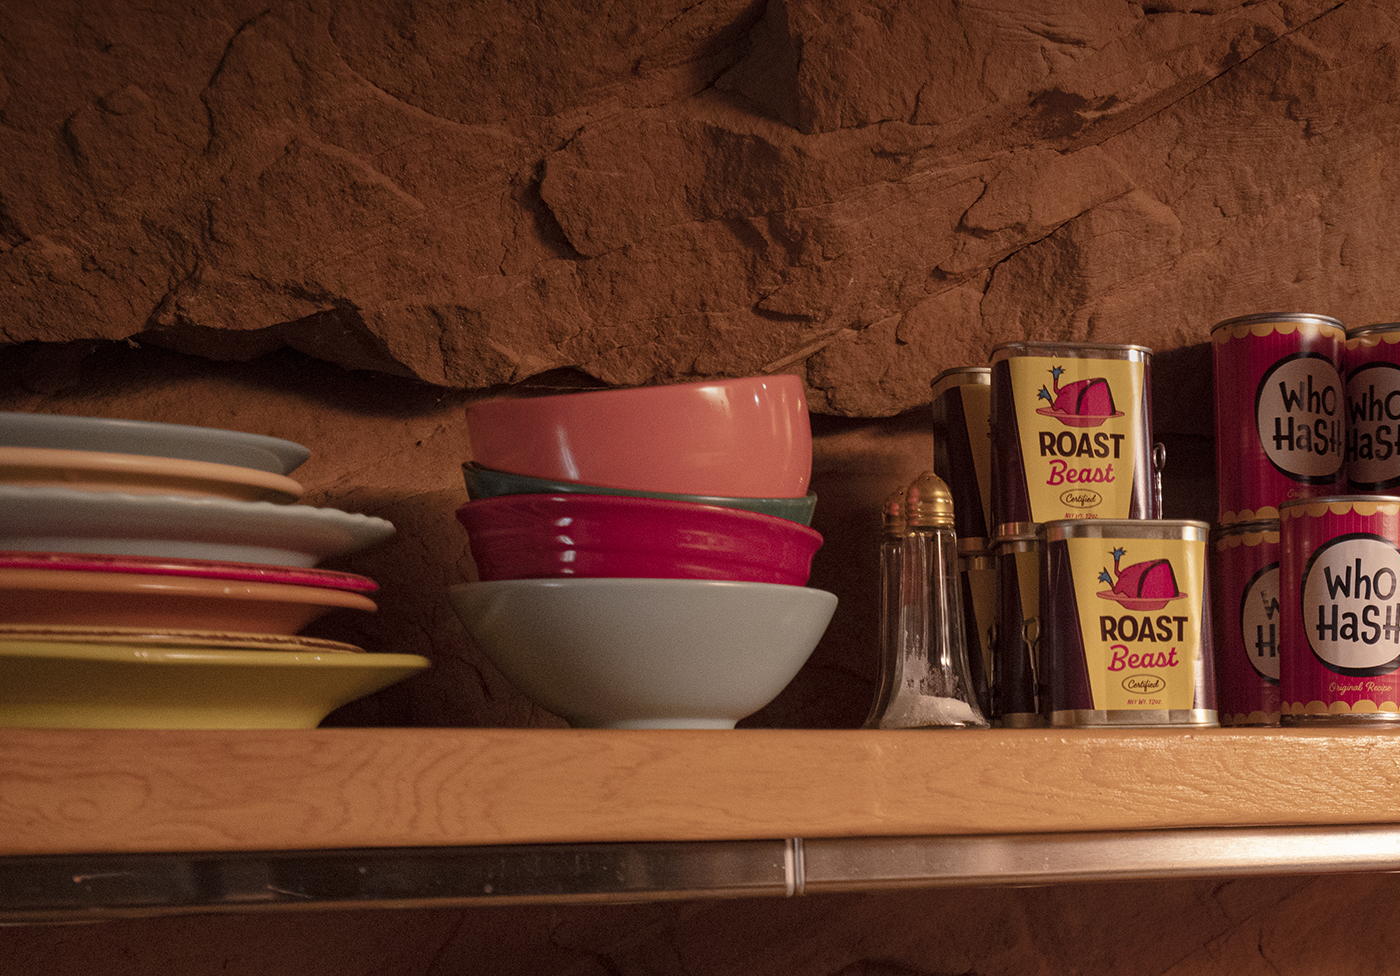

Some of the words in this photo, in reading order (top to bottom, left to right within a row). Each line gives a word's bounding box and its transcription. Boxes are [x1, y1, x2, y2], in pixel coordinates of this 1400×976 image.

[1039, 431, 1125, 459] ROAST
[1046, 459, 1115, 486] Beast
[1066, 493, 1096, 506] Certified
[1099, 615, 1188, 643] ROAST
[1107, 644, 1179, 672] Beast
[1128, 679, 1159, 692] Certified
[1329, 682, 1363, 696] Original
[1365, 682, 1392, 693] Recipe
